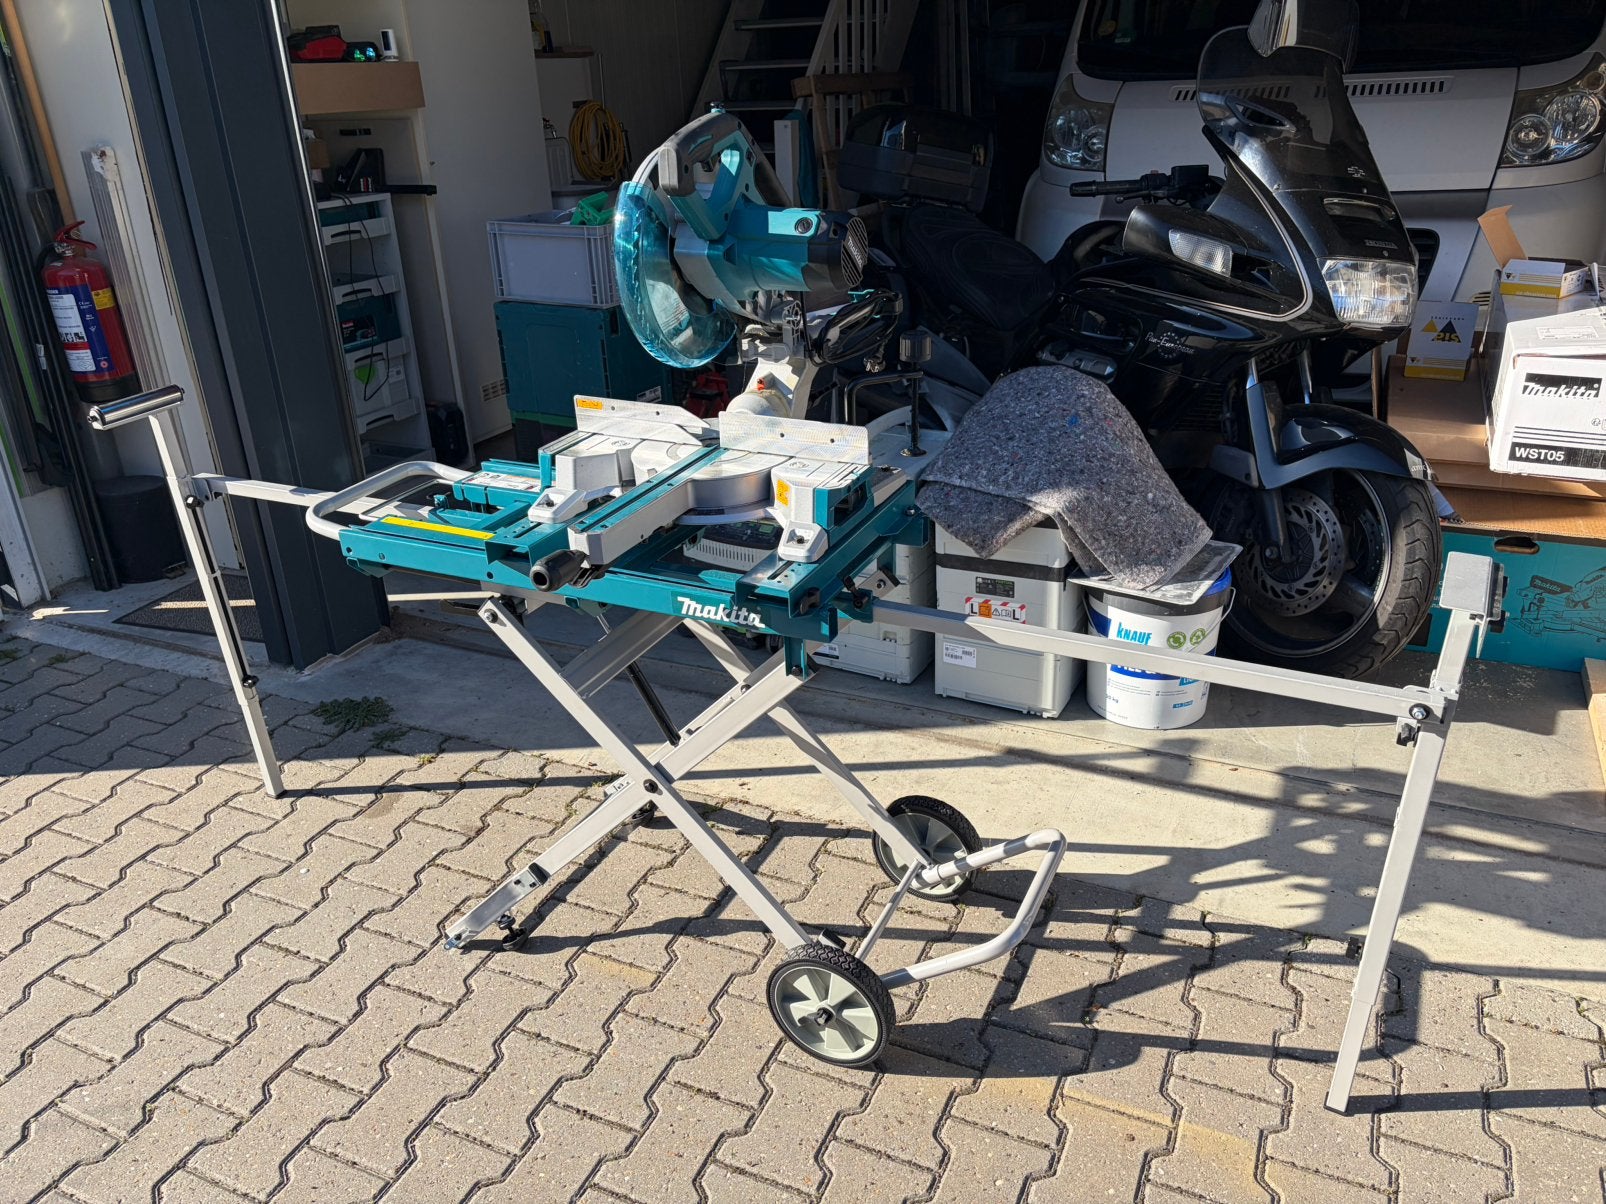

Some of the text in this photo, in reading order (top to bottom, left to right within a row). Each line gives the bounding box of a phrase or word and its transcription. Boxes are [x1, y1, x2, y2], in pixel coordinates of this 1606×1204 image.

[1515, 446, 1565, 462] WST05
[970, 603, 978, 614] L
[1012, 609, 1020, 620] L
[1117, 622, 1152, 646] KNAUF
